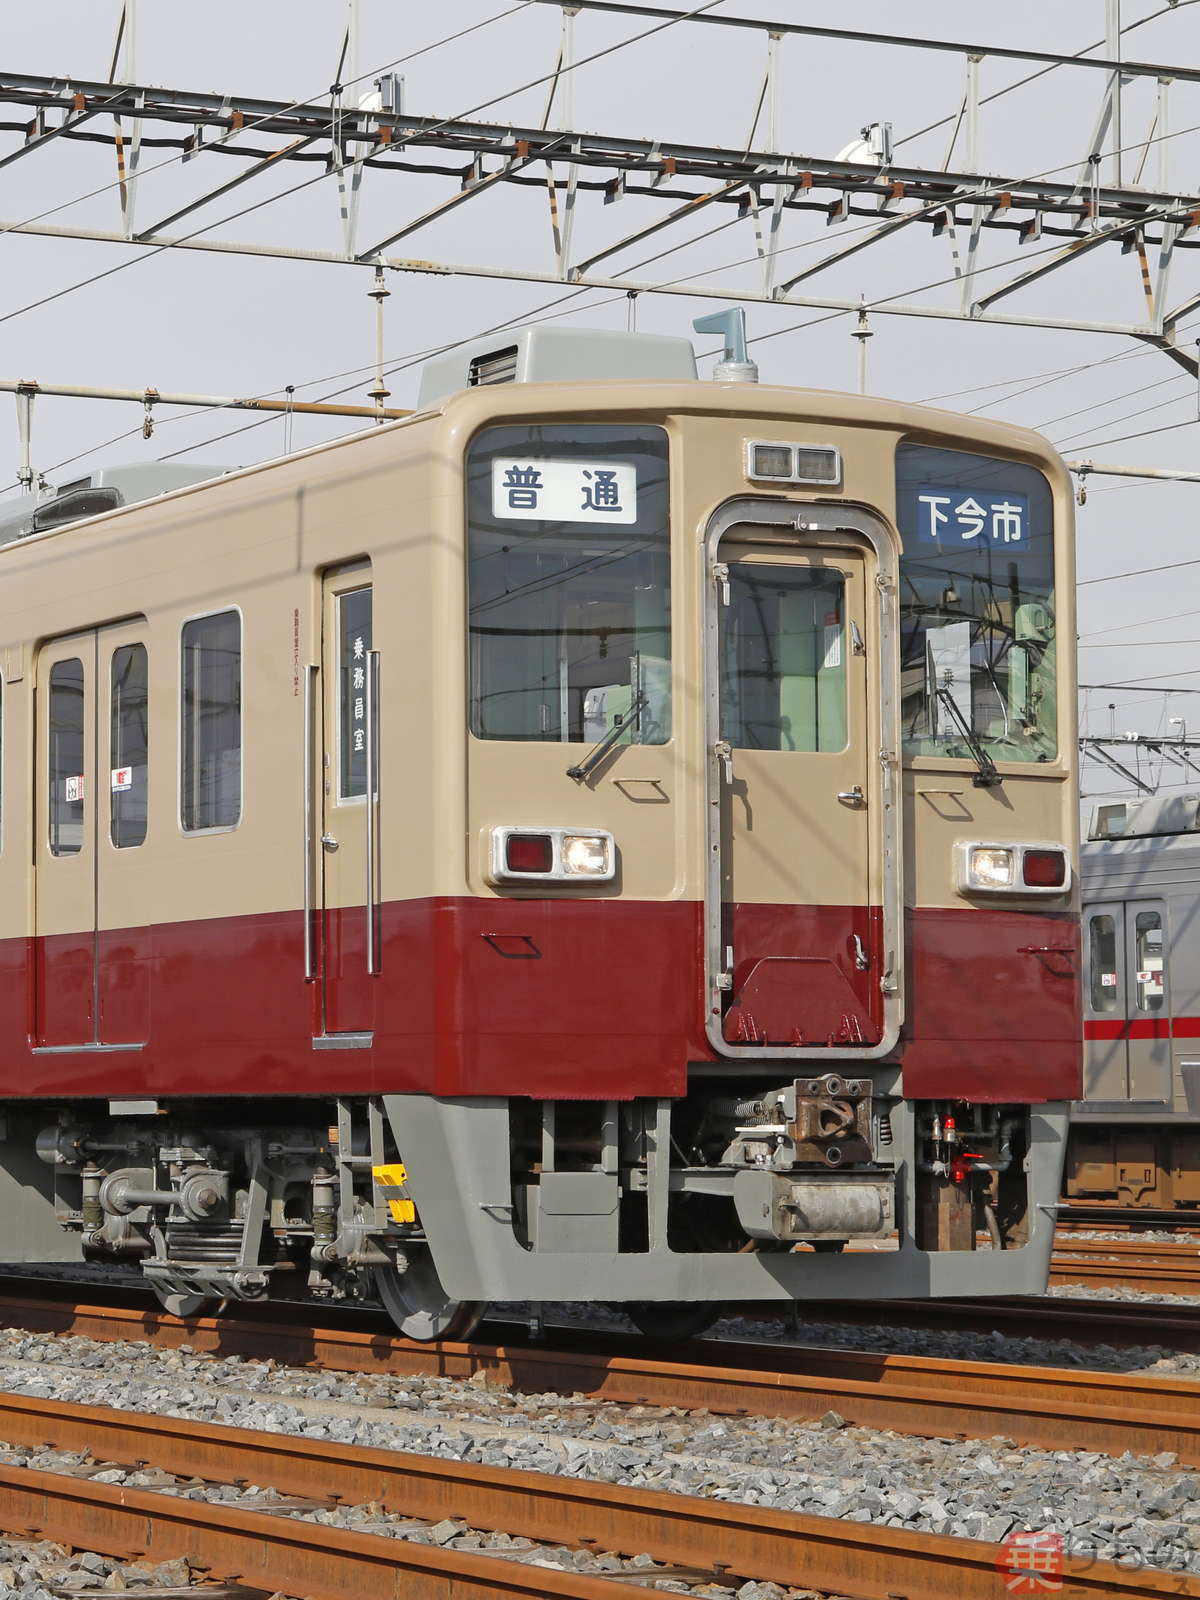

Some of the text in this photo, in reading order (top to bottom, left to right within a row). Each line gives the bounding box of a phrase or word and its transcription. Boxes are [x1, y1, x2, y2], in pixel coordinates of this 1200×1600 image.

[502, 465, 623, 512] 普通
[918, 495, 1023, 542] 下今市
[353, 636, 365, 752] 乗務員室
